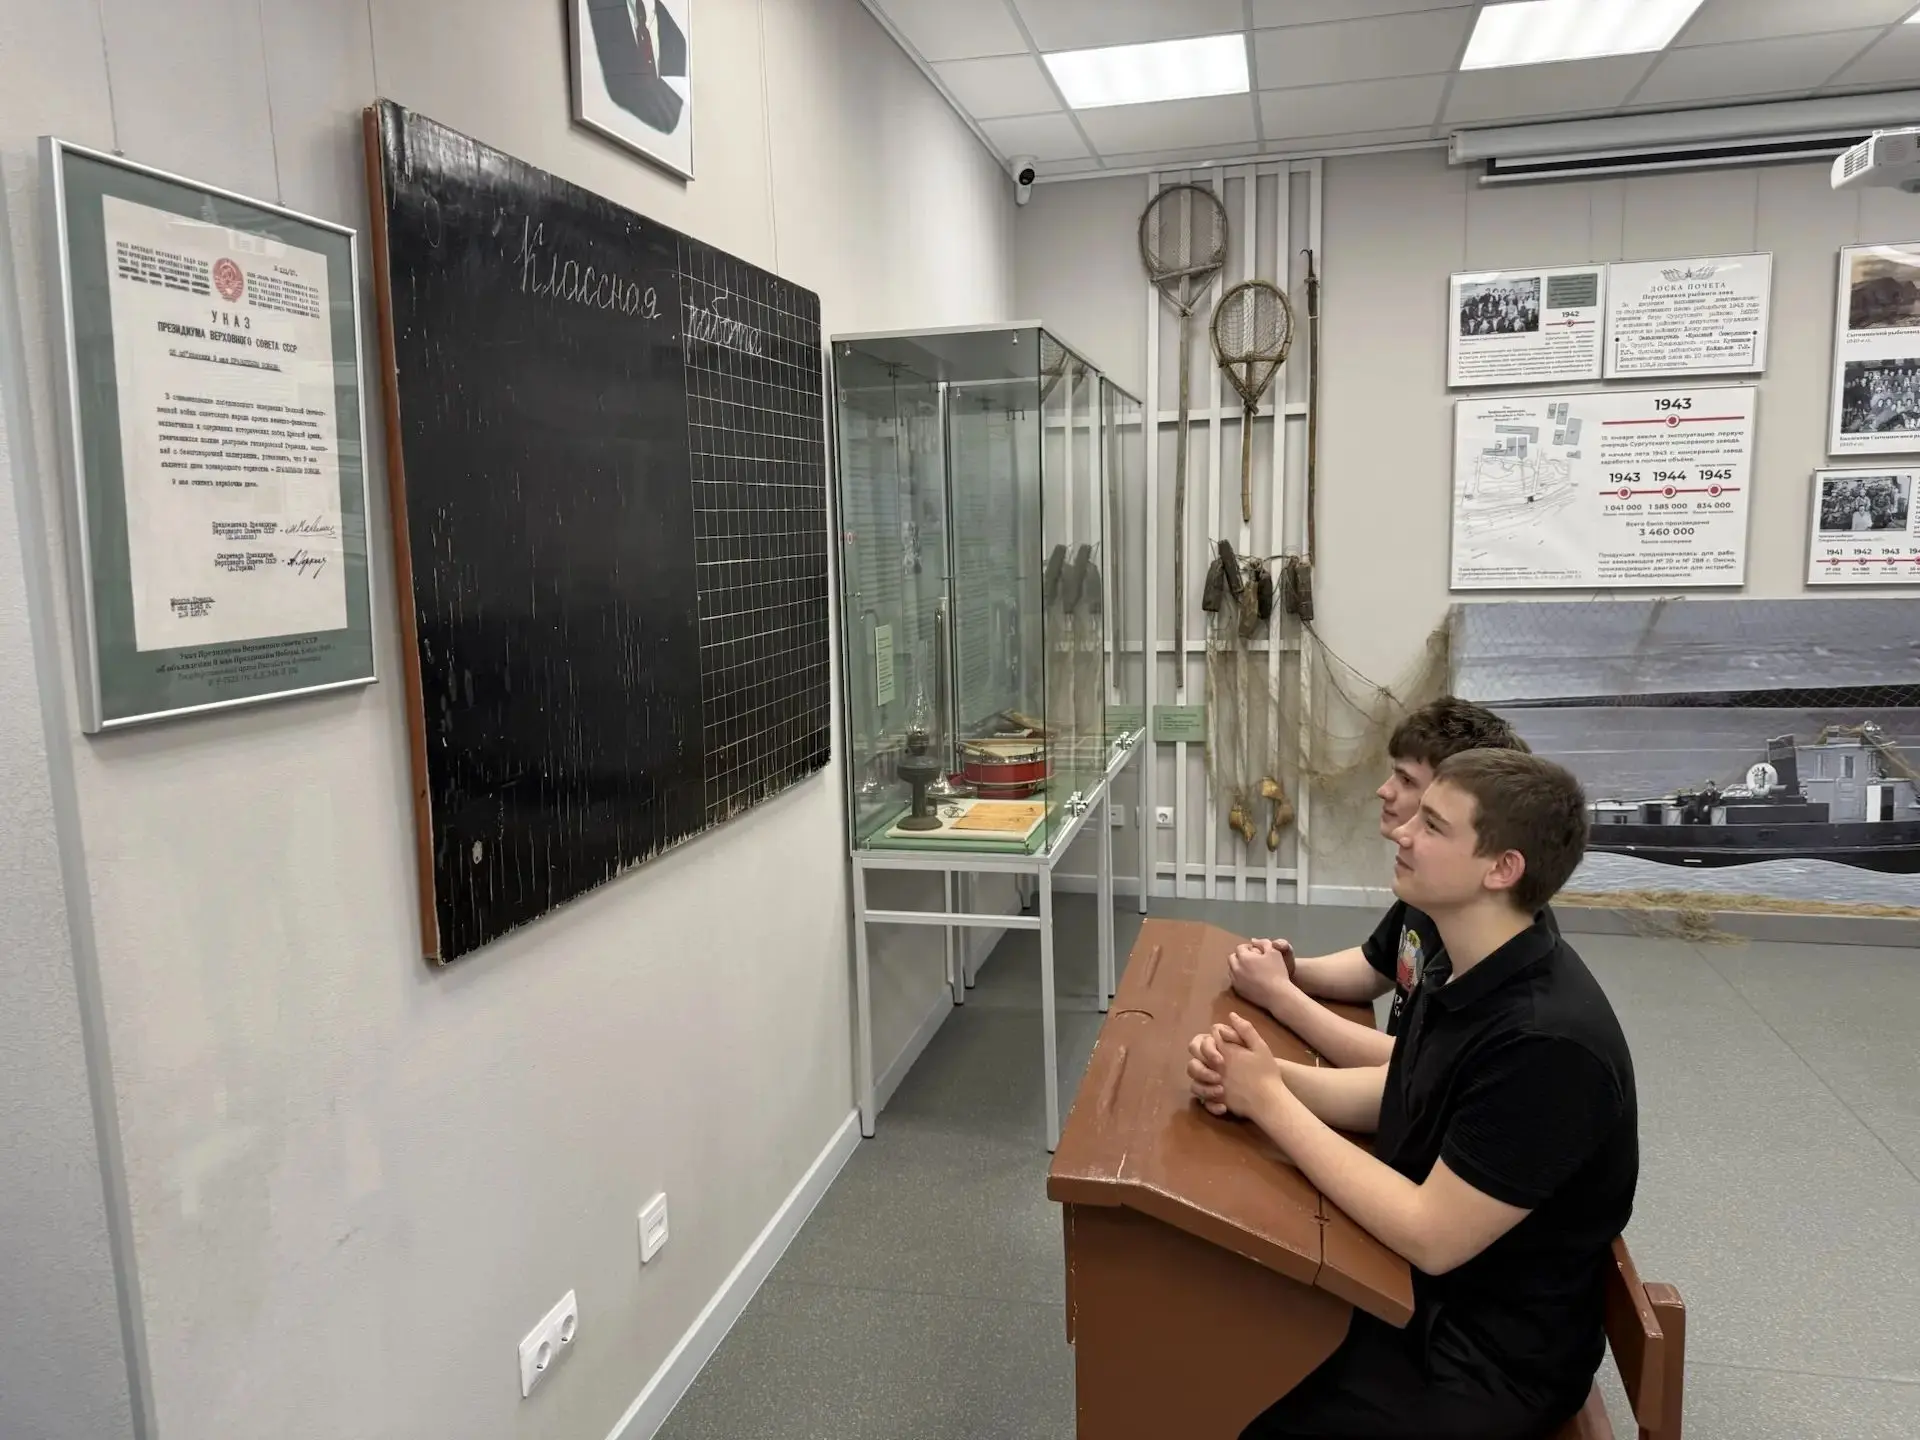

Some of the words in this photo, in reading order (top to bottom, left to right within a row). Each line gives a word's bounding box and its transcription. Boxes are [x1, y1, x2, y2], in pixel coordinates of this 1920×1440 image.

[513, 215, 663, 320] Классная
[1651, 285, 1683, 293] ДОСКА
[157, 321, 205, 338] ПРЕЗИДИУМА
[210, 330, 252, 346] ВЕРХОВНОГО
[256, 339, 279, 351] СОВЕТА
[282, 343, 298, 353] СССР
[1654, 398, 1692, 411] 1943
[1629, 440, 1670, 448] Сургутского
[1609, 472, 1641, 483] 1943
[1653, 470, 1687, 481] 1944
[1699, 469, 1732, 480] 1945
[1639, 528, 1645, 536] 3
[1649, 527, 1670, 536] 460
[1673, 527, 1695, 535] 000
[1826, 548, 1843, 556] 1941
[1853, 548, 1872, 556] 1942
